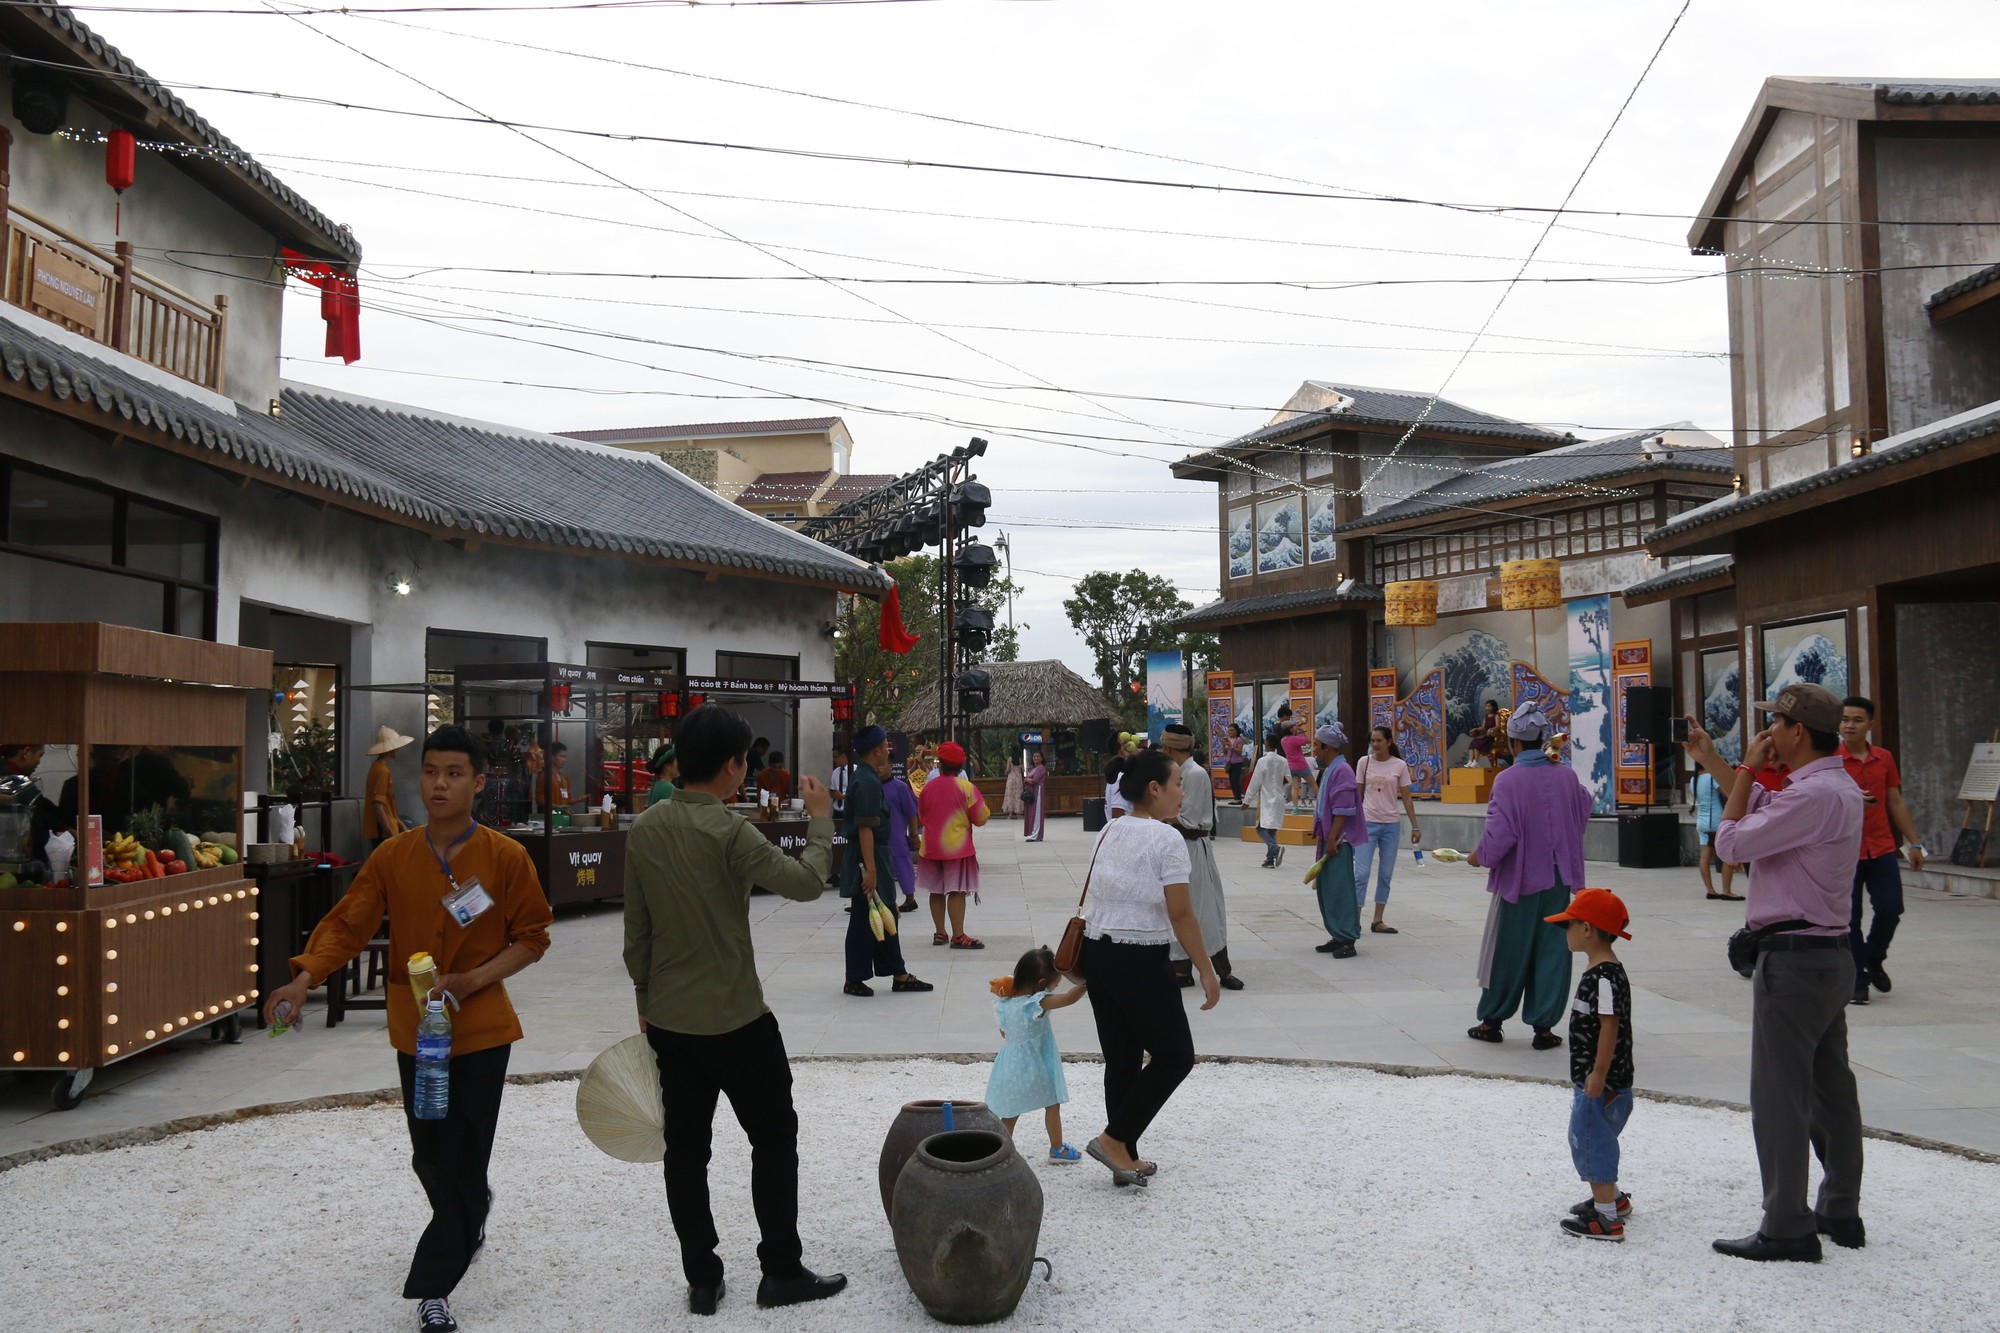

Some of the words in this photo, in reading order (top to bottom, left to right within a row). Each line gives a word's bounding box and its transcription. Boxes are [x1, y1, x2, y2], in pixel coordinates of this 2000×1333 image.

[37, 268, 60, 290] PHONG
[567, 670, 582, 679] quay
[730, 679, 748, 689] Bánh
[749, 682, 763, 690] bao
[810, 683, 828, 692] thánh
[780, 835, 793, 850] Mỳ
[569, 851, 580, 867] Vịt
[581, 851, 602, 867] quay
